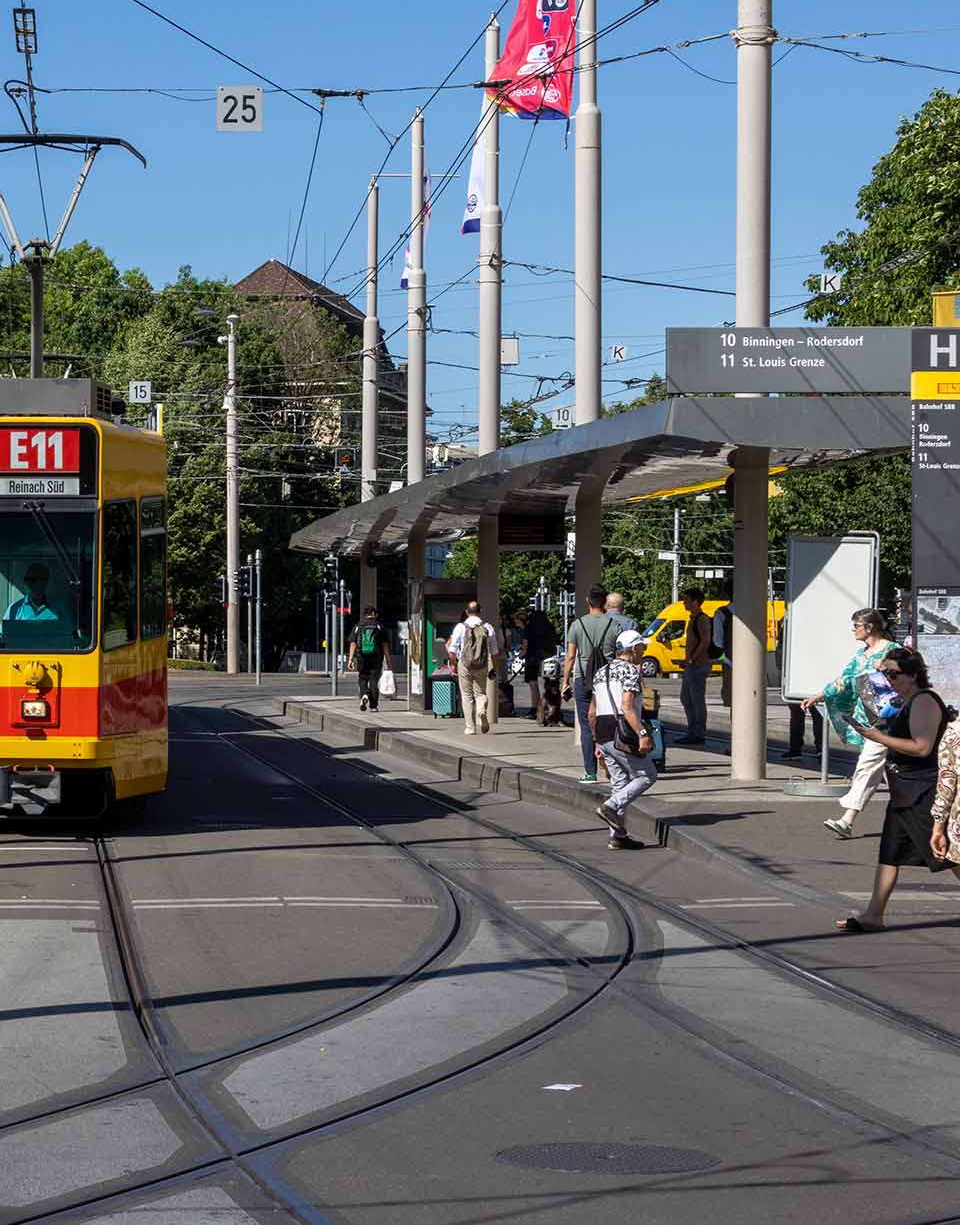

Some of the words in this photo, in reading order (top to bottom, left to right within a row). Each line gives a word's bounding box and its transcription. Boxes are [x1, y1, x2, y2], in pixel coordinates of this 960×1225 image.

[223, 95, 256, 123] 25
[824, 275, 837, 291] K
[719, 333, 736, 347] 10
[742, 336, 795, 349] Binningen
[807, 335, 864, 347] Rodersdorf
[613, 346, 625, 360] K
[929, 334, 957, 367] H
[720, 354, 735, 368] 11
[742, 357, 756, 367] St.
[759, 356, 786, 367] Louis
[789, 357, 825, 367] Grenze
[134, 385, 147, 399] 15
[556, 410, 570, 422] 10
[918, 423, 929, 432] 10
[10, 431, 63, 470] E11
[918, 453, 928, 462] 11
[9, 480, 45, 494] Reinach
[47, 480, 65, 494] Süd
